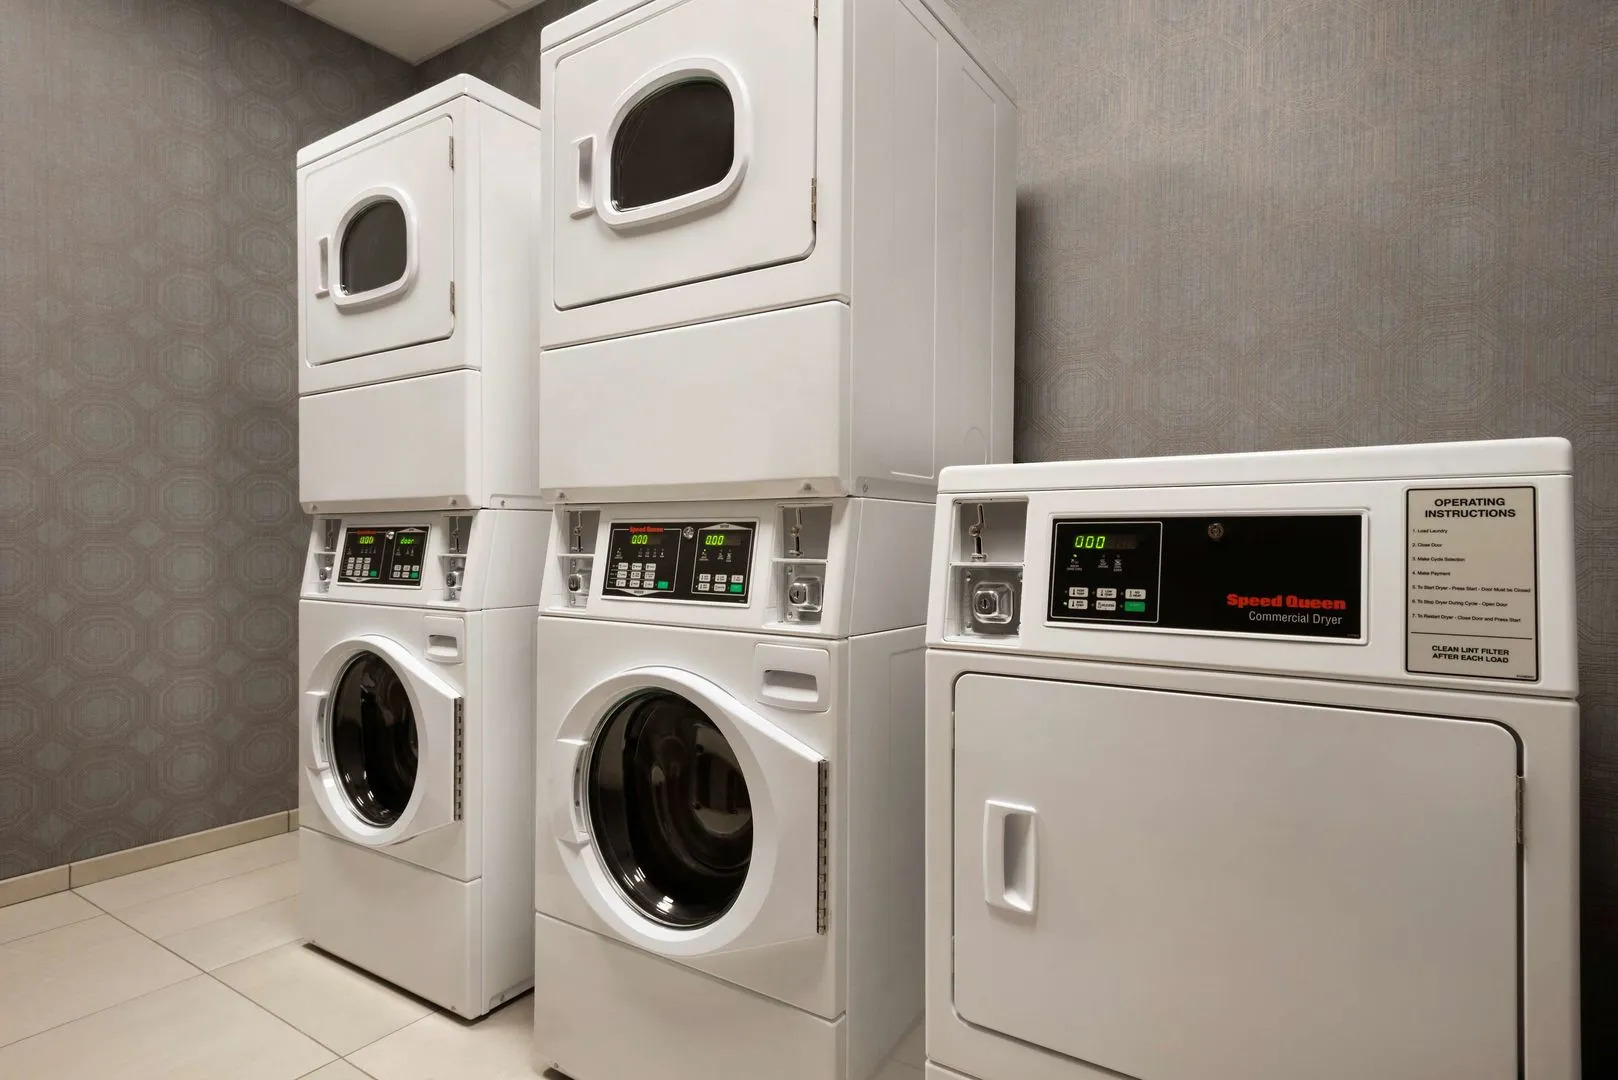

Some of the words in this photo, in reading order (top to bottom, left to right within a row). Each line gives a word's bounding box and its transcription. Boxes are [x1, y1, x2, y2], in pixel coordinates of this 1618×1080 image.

[1434, 497, 1505, 507] OPERATING
[1425, 509, 1516, 518] INSTRUCTIONS
[1074, 535, 1106, 549] 000
[1226, 594, 1282, 608] Speed
[1286, 596, 1346, 610] Queen
[1248, 610, 1310, 623] Commercial
[1312, 614, 1343, 626] Dryer
